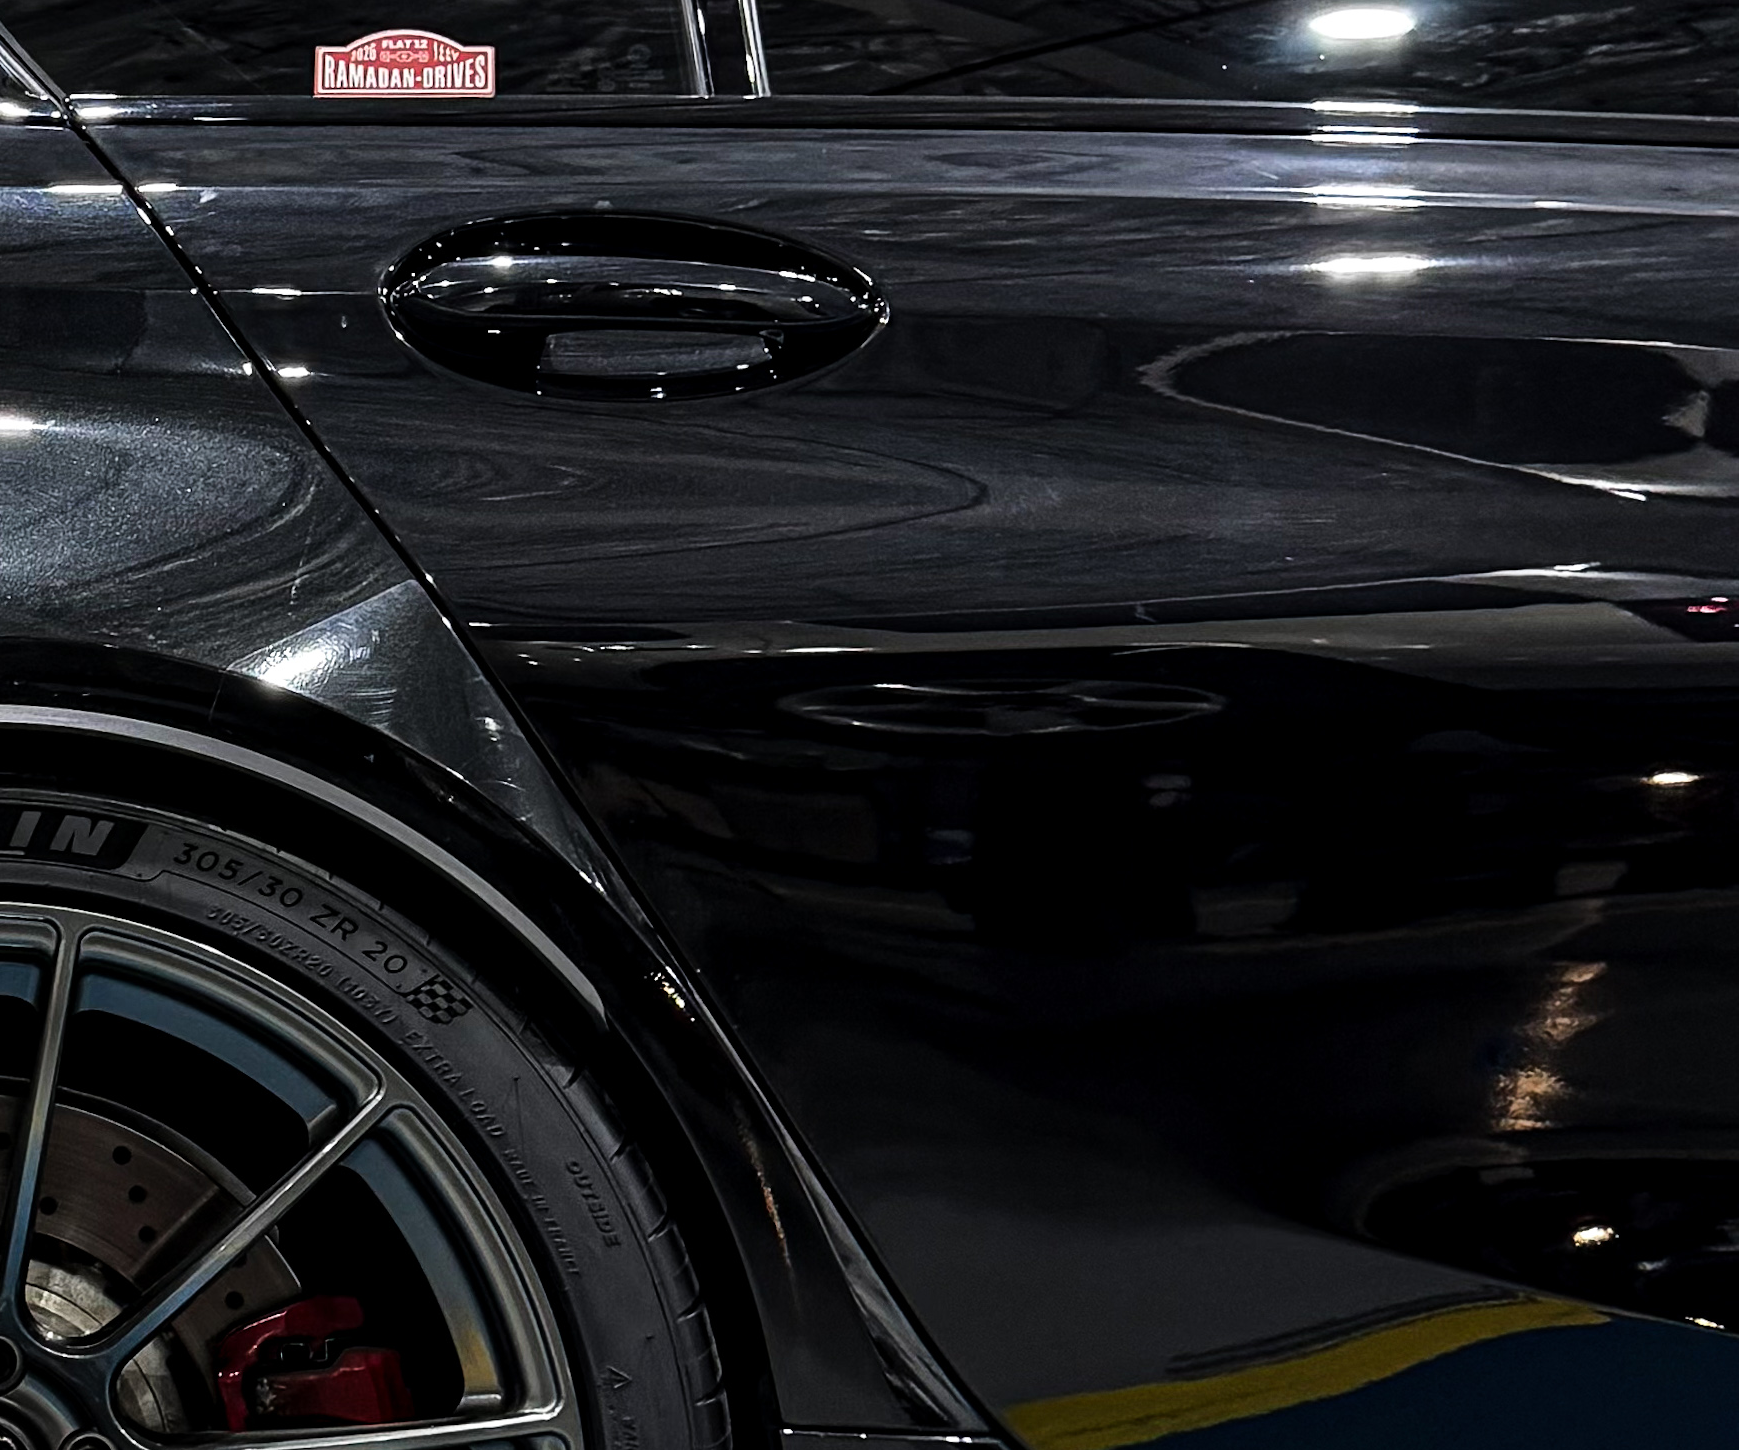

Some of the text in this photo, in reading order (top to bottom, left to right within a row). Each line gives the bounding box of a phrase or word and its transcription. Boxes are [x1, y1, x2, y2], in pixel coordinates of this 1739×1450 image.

[324, 54, 486, 88] RAMADAN-DRIVES
[172, 842, 410, 975] 305/30 ZR 20
